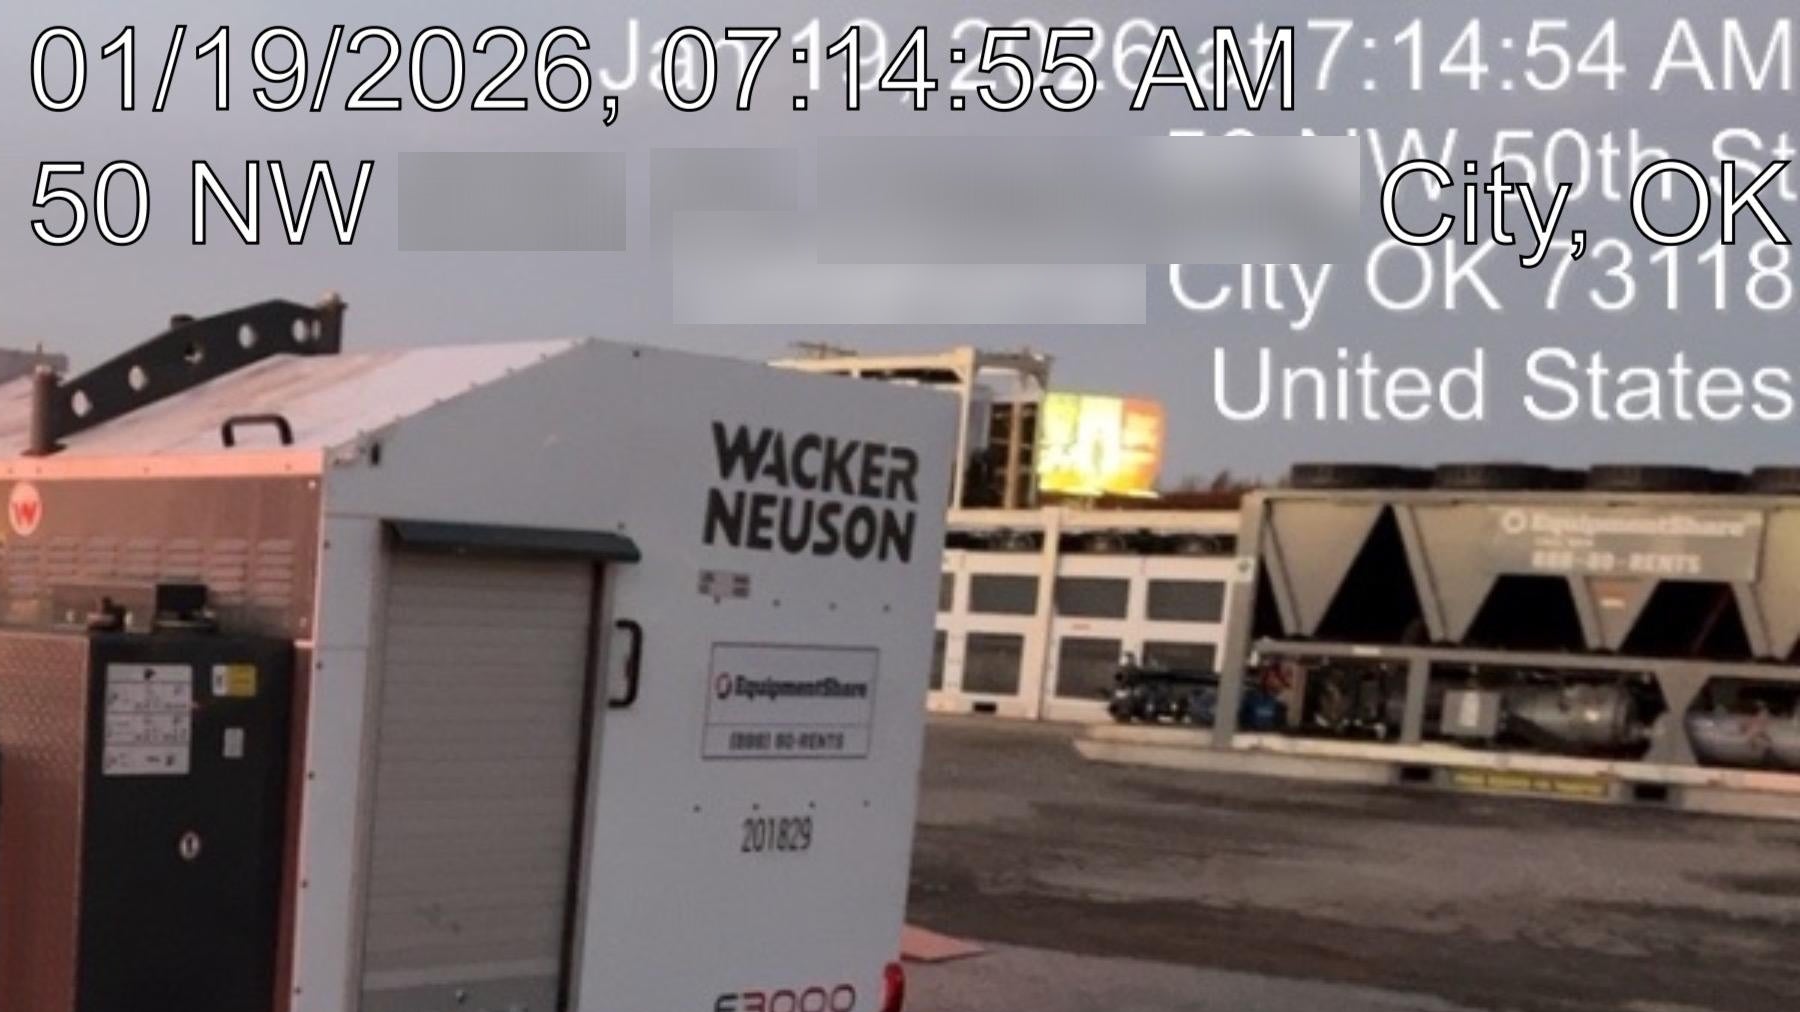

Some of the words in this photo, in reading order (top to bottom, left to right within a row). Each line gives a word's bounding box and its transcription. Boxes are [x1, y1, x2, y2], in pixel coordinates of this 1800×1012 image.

[712, 420, 921, 503] WACKER
[702, 487, 917, 563] NEUSON
[734, 673, 868, 701] EquipmentShare
[740, 816, 815, 853] 201829
